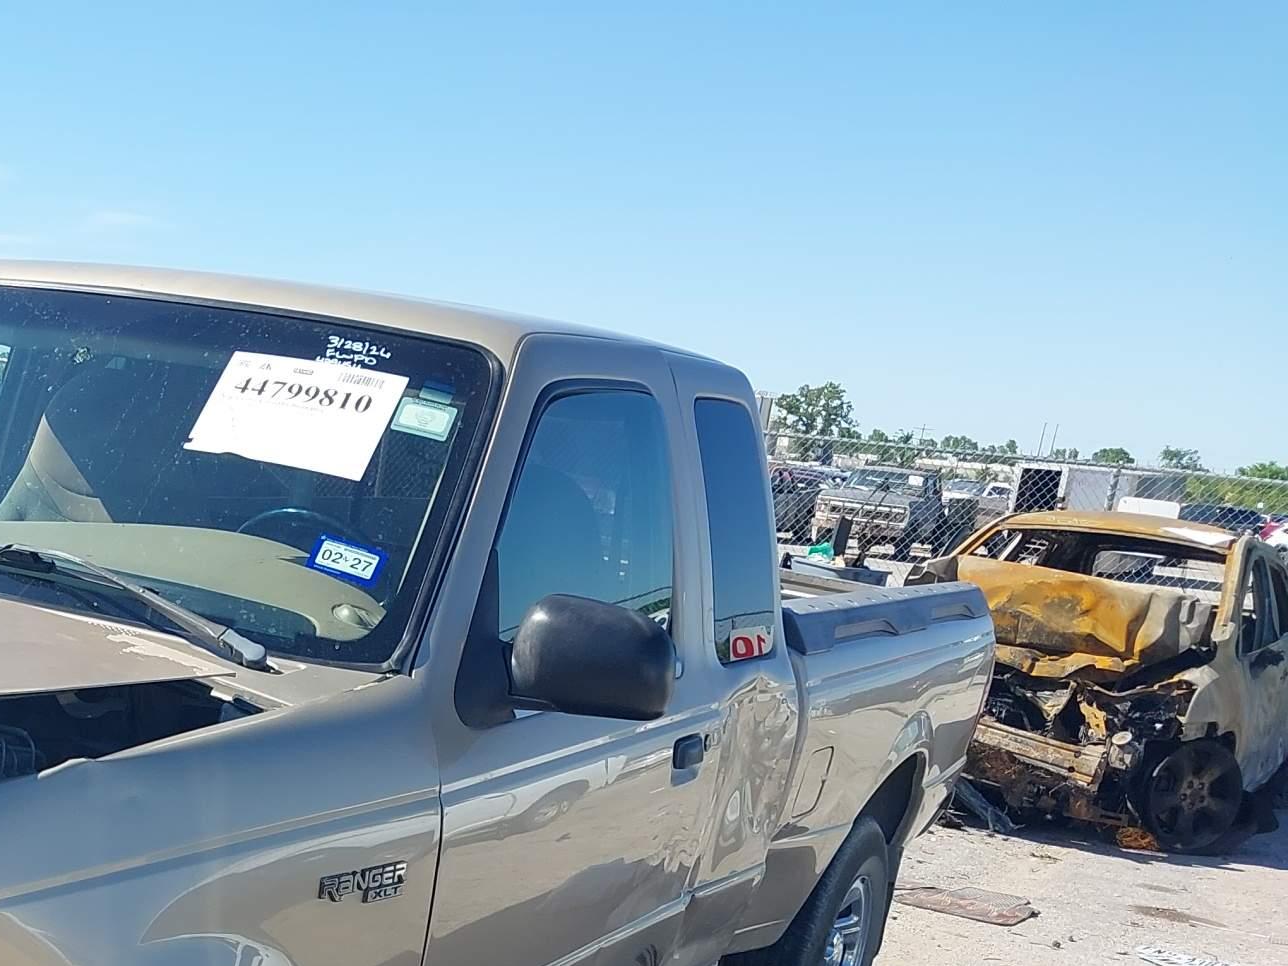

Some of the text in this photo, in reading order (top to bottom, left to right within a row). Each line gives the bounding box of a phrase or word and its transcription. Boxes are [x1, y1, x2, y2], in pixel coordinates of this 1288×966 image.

[234, 377, 373, 413] 44799810
[322, 549, 343, 564] 02
[350, 557, 373, 572] 27
[318, 860, 408, 902] RANGER
[371, 885, 402, 900] XLT
